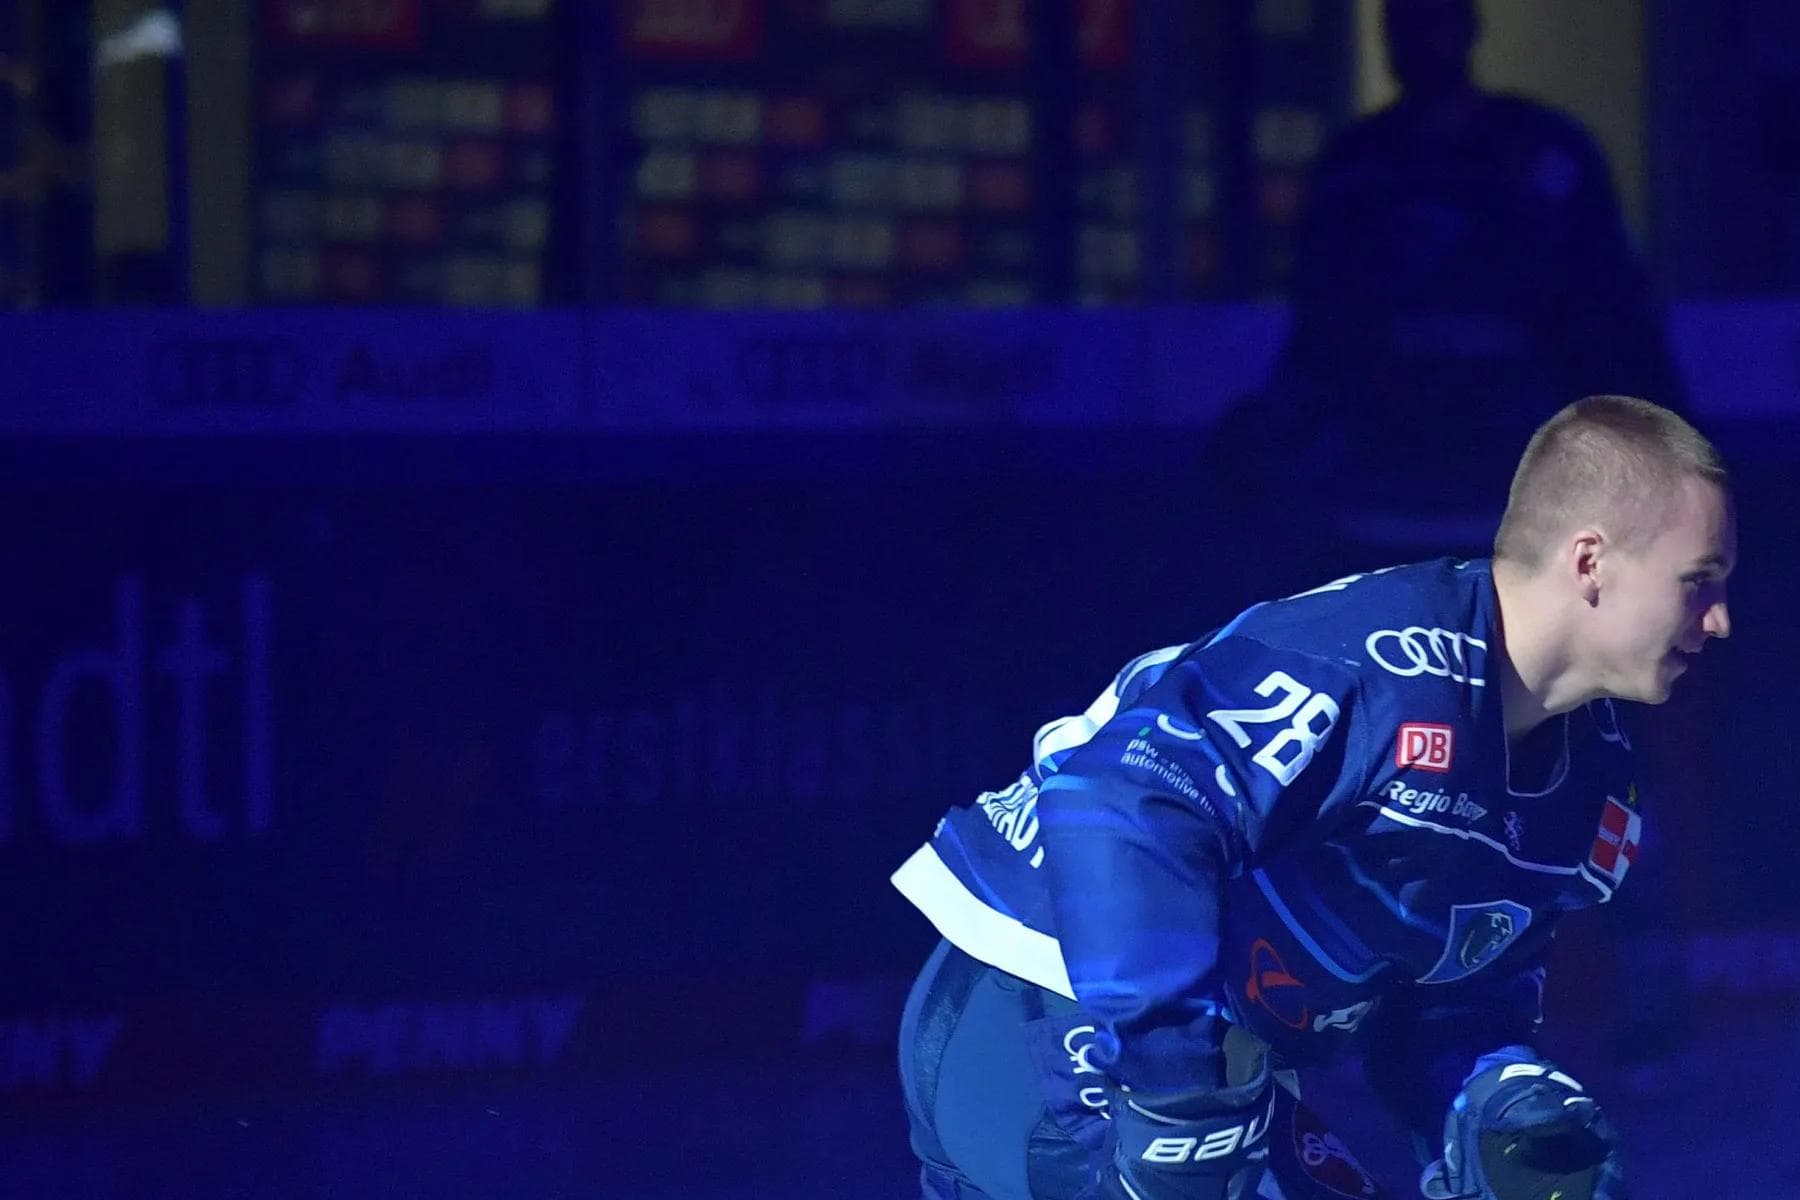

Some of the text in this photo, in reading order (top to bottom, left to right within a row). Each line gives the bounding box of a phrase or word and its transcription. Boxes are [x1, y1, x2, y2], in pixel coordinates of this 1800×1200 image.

[1206, 671, 1341, 787] 28
[1406, 730, 1448, 765] DB
[1379, 780, 1452, 815] Regio
